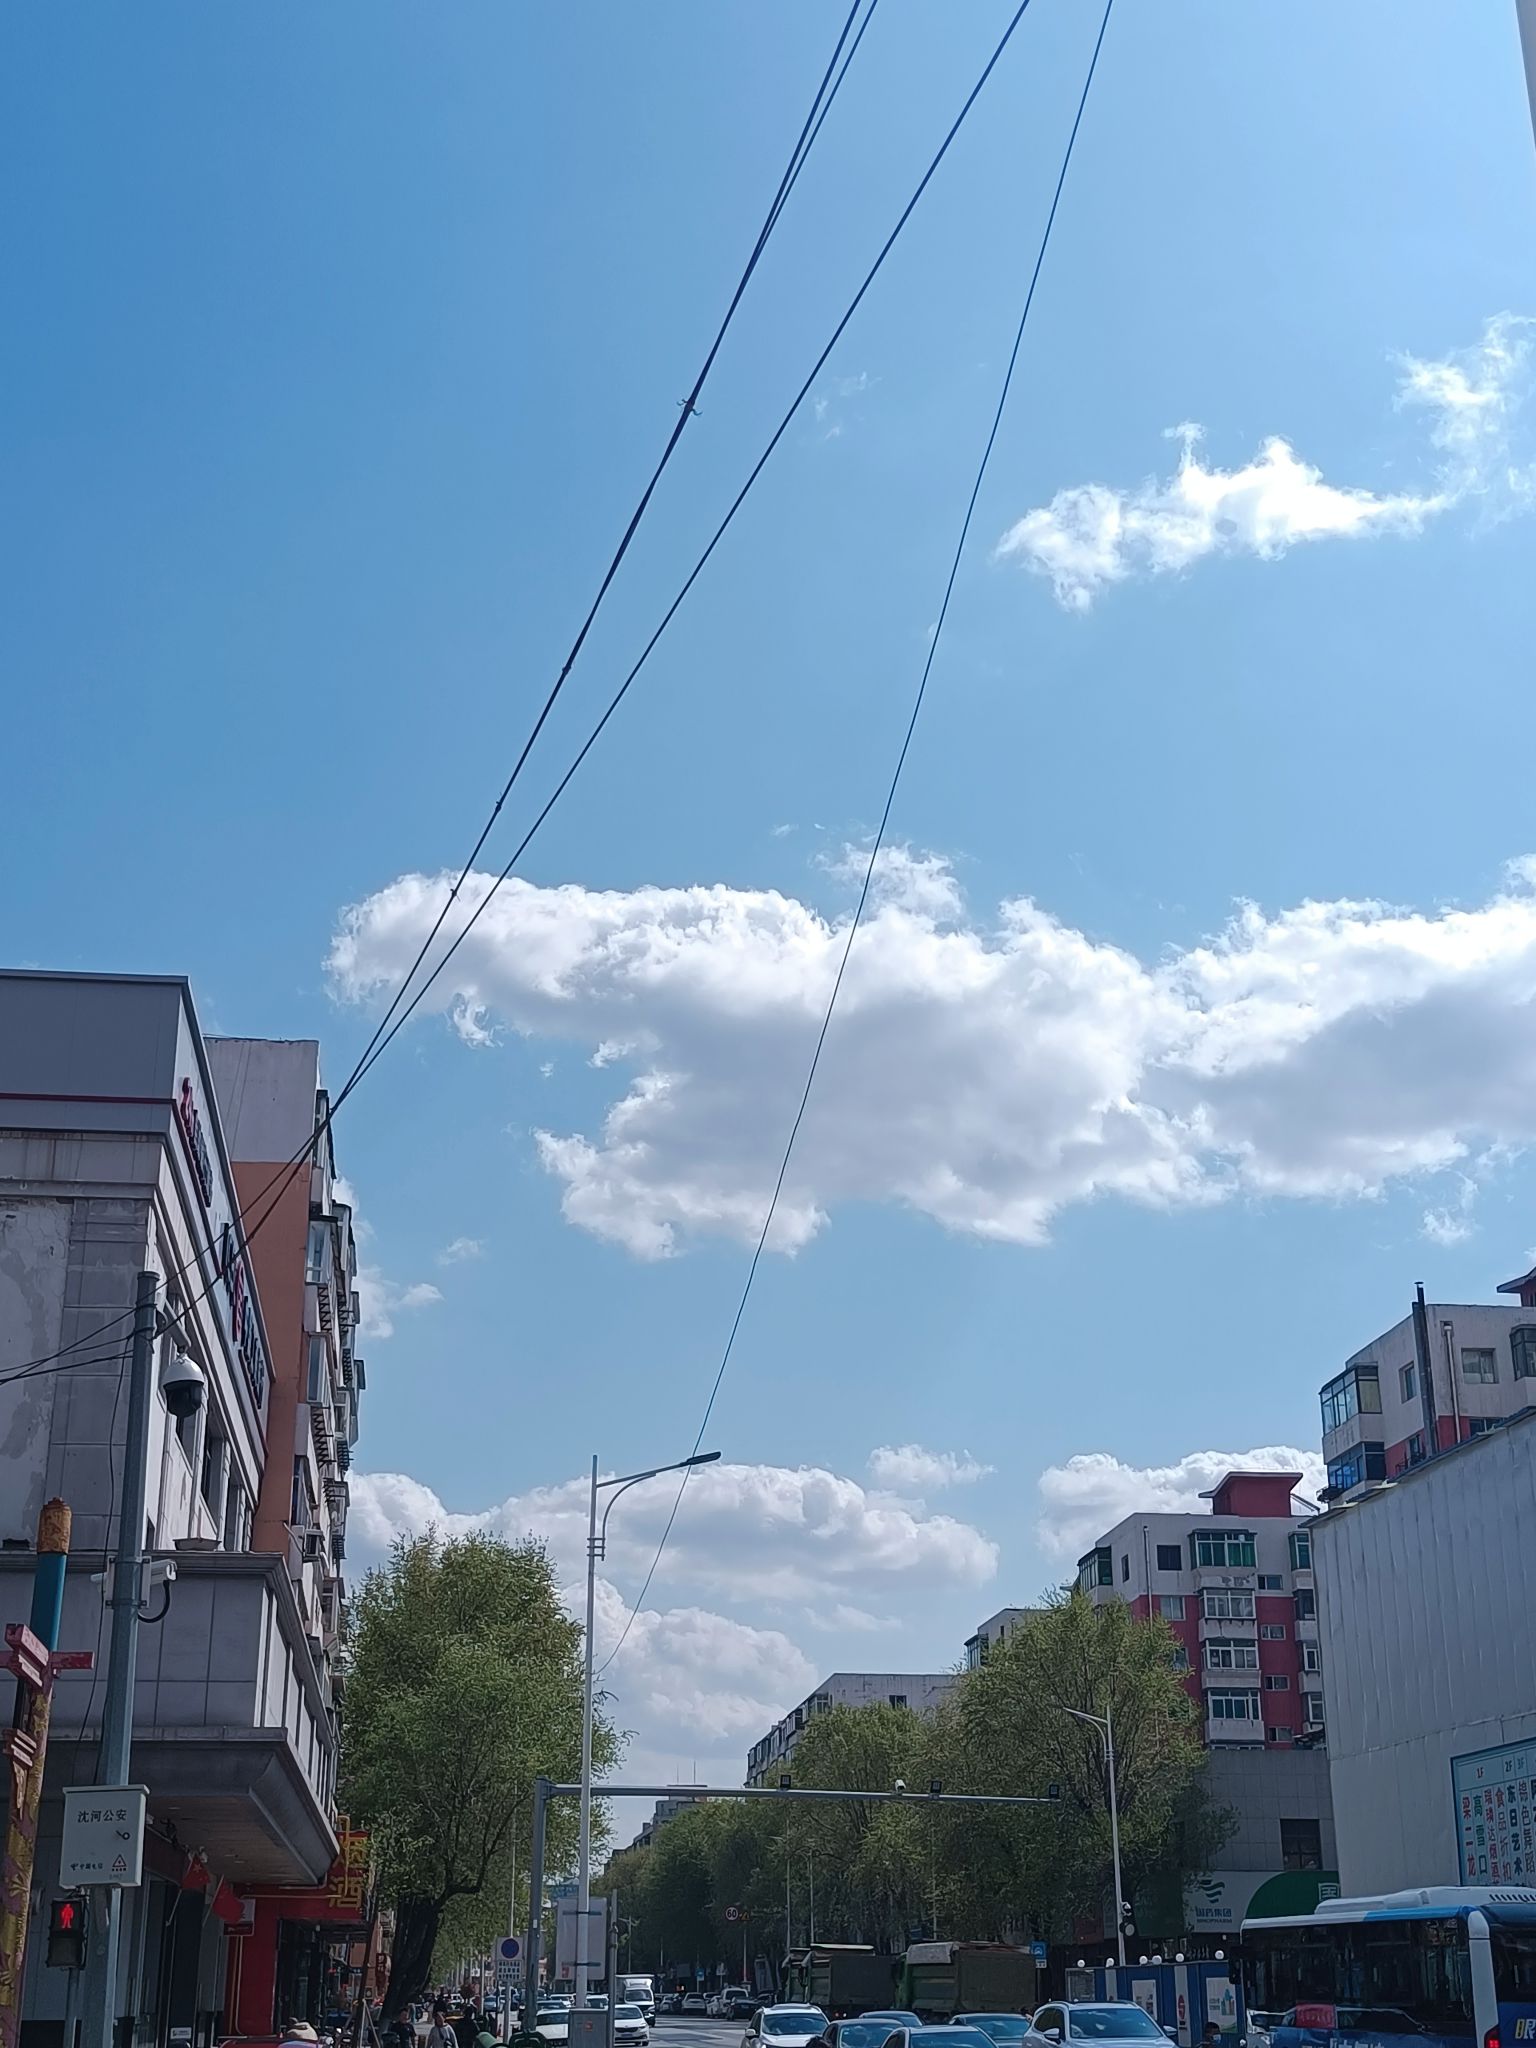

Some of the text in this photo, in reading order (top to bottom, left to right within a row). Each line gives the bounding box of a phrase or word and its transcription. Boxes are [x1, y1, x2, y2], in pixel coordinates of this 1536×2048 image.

[1505, 1760, 1513, 1773] 2F
[78, 1808, 127, 1823] 沈河公安
